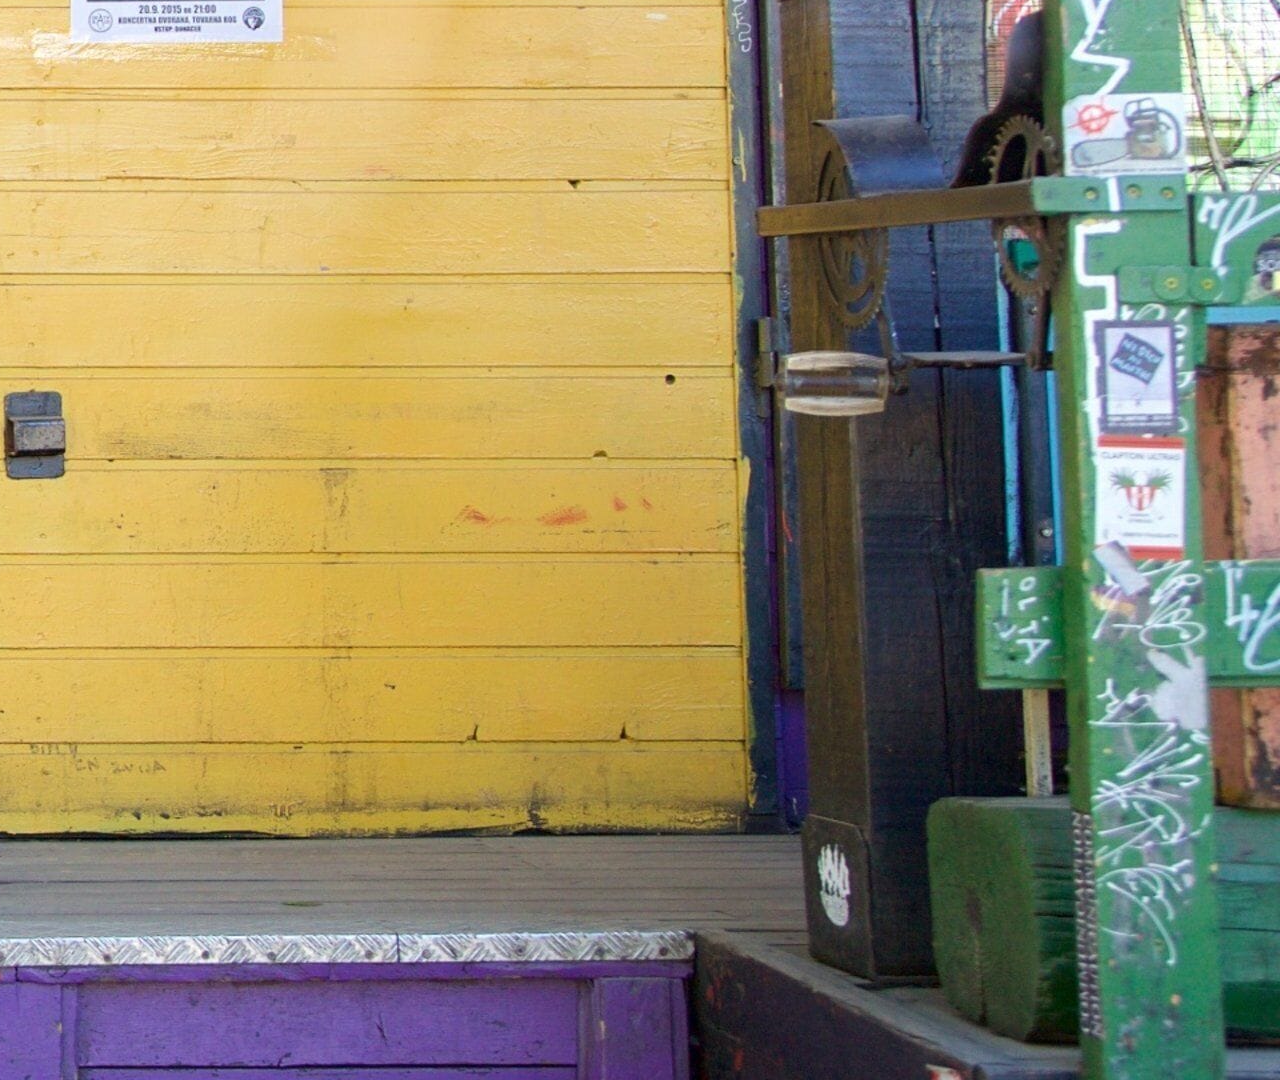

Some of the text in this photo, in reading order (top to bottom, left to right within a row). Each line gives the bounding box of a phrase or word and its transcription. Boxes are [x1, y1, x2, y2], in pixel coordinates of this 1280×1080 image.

[139, 5, 216, 13] 20.9. 2015 21:00
